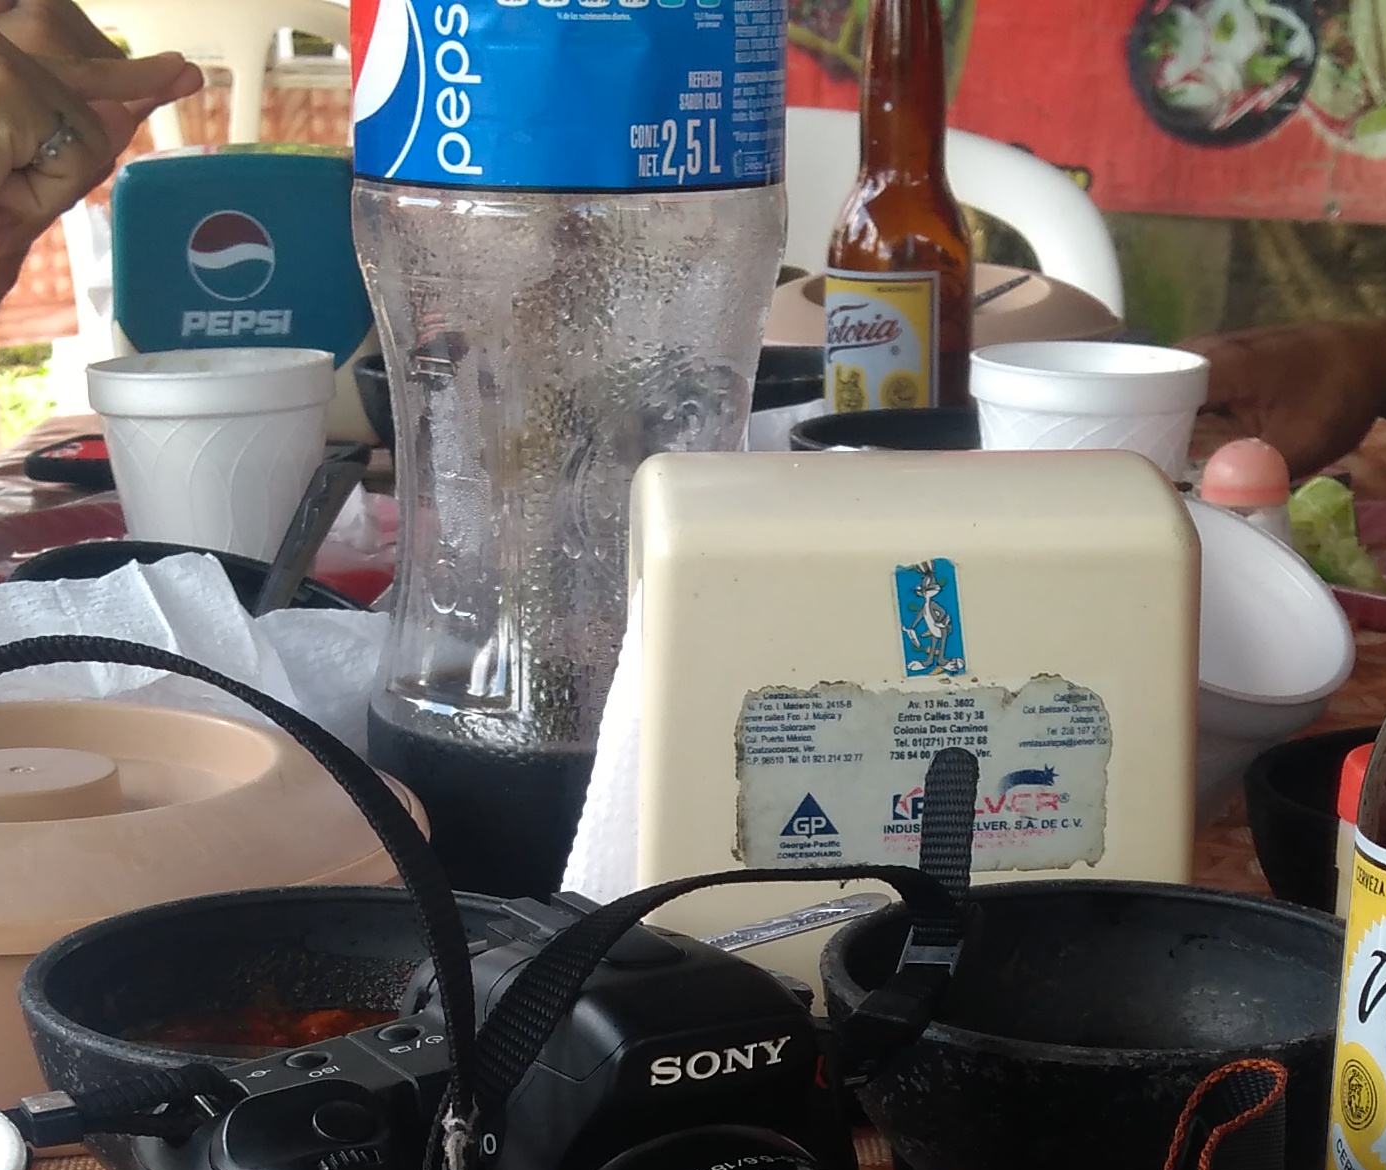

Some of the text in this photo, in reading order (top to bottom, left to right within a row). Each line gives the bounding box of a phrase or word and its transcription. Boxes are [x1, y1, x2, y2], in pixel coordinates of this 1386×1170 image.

[435, 4, 482, 175] peps
[630, 124, 660, 149] CONT.
[709, 118, 721, 174] L
[638, 154, 660, 177] NET.
[180, 309, 293, 337] PEPSI
[783, 702, 811, 710] Madero
[908, 700, 922, 709] Av.
[924, 700, 934, 708] 13
[936, 700, 952, 708] No.
[898, 713, 922, 722] Entre
[924, 712, 951, 721] Calles
[893, 724, 988, 735] Colonia Dos Caminos
[894, 738, 910, 747] Tel.
[947, 736, 962, 745] 717
[853, 753, 864, 761] 77
[976, 748, 992, 758] Ver.
[793, 817, 827, 834] GP
[1014, 820, 1037, 830] S.A.
[1041, 819, 1057, 829] DE
[777, 851, 842, 859] CONCESIONARIO
[1356, 865, 1386, 897] CERVEZA
[649, 1035, 792, 1087] SONY
[308, 1065, 341, 1079] ISO
